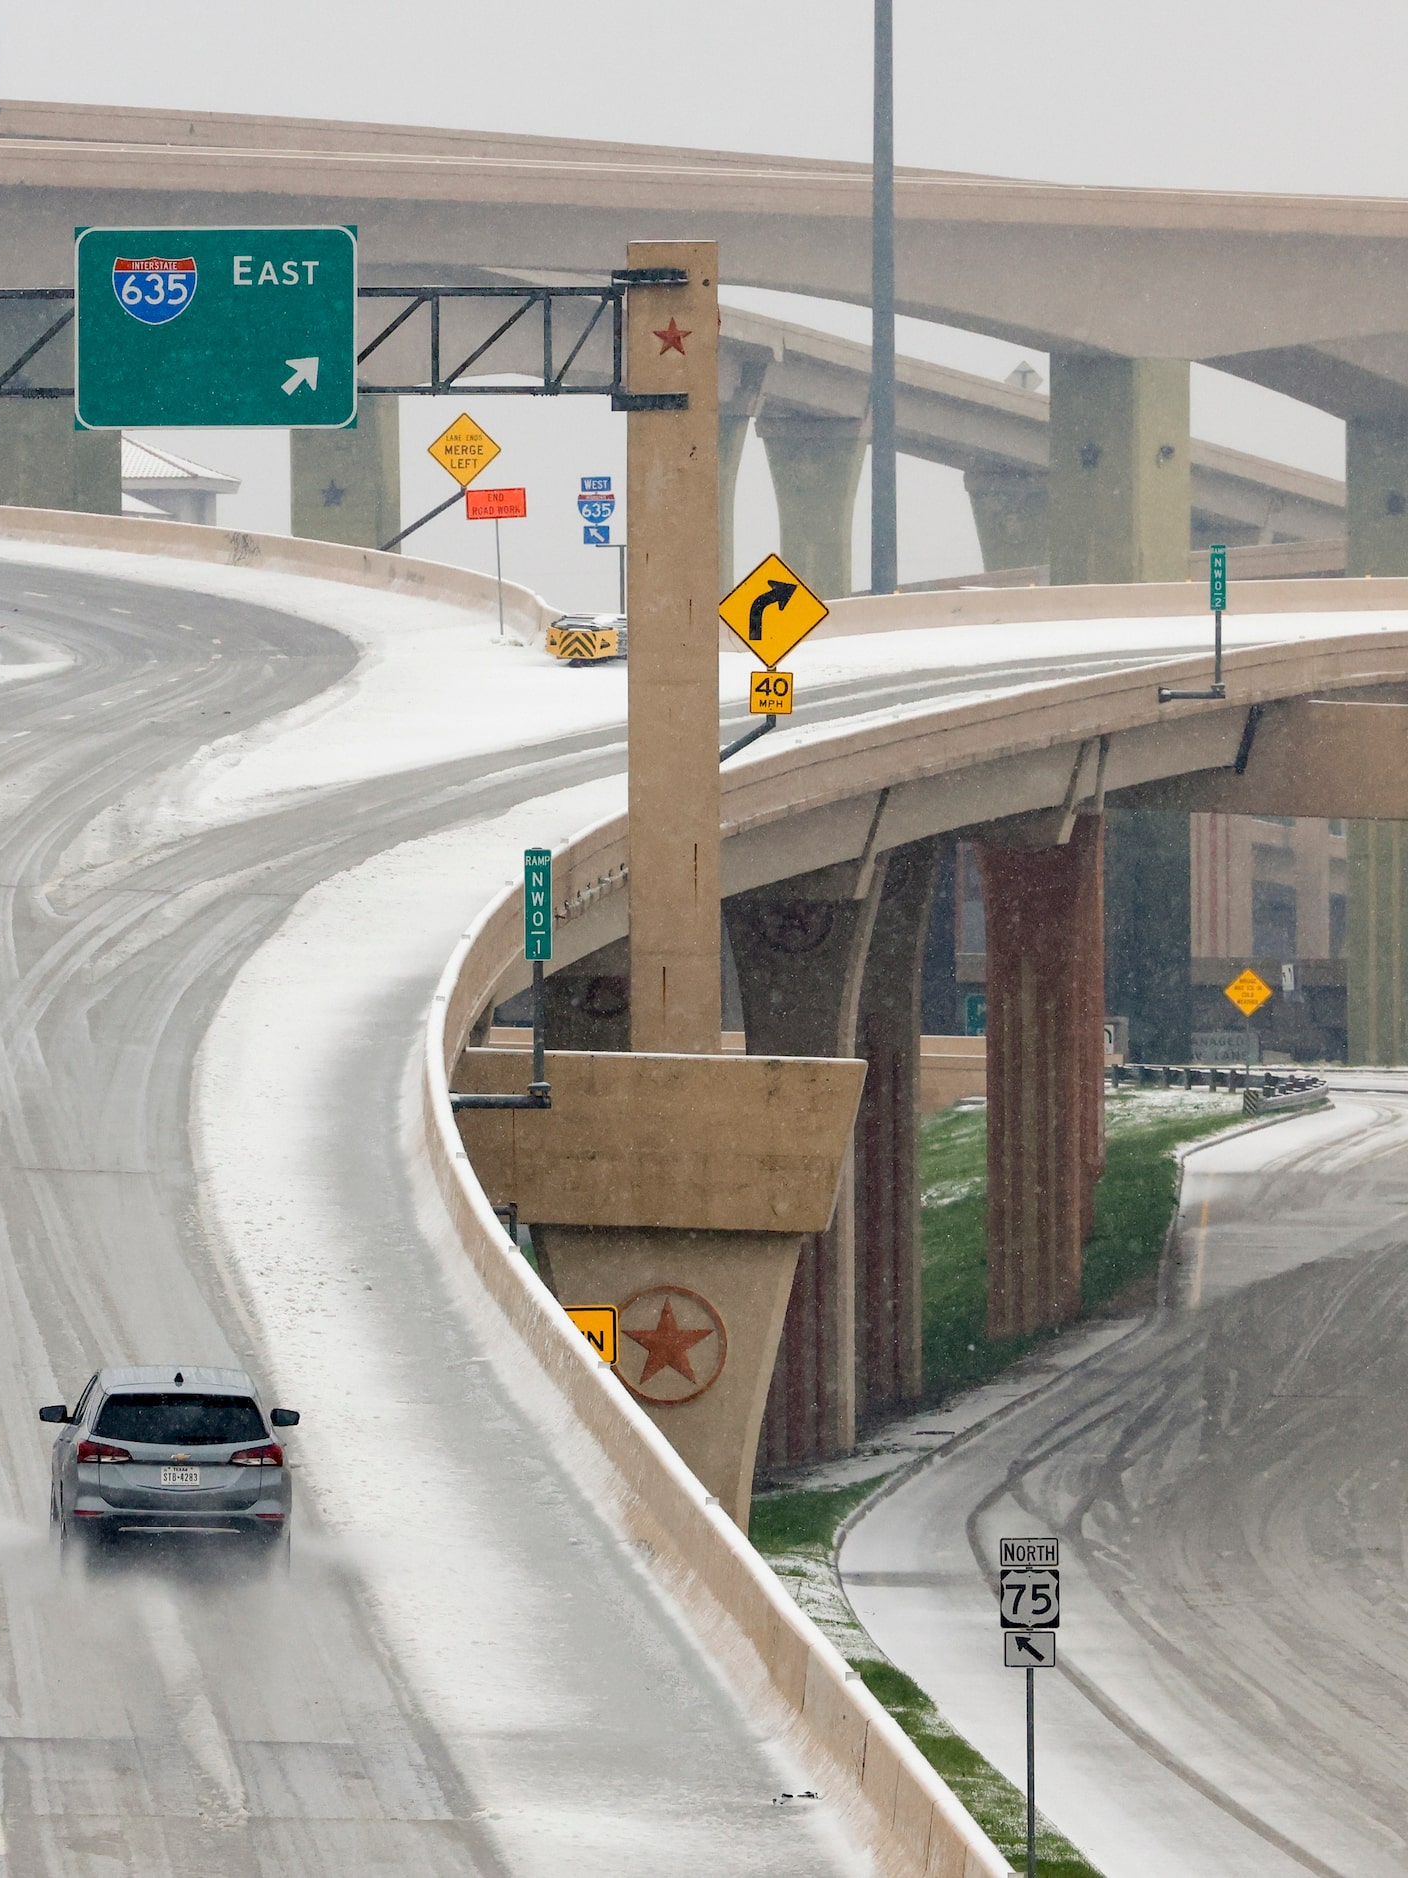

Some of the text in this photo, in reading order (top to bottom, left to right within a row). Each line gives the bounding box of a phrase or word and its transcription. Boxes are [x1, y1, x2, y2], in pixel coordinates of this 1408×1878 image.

[132, 261, 177, 271] INTERSTATE
[233, 255, 320, 286] EAST
[121, 274, 188, 305] 635
[445, 434, 462, 442] LANE
[444, 445, 484, 455] MERGE
[450, 459, 478, 469] LEFT
[583, 479, 608, 490] WEST
[487, 493, 504, 502] END
[472, 504, 520, 516] ROAD WORK
[582, 503, 611, 518] 635
[755, 677, 789, 697] 40
[759, 700, 783, 708] MPH
[525, 855, 551, 866] RAMP
[1004, 1543, 1055, 1562] NORTH
[1005, 1583, 1052, 1615] 75
